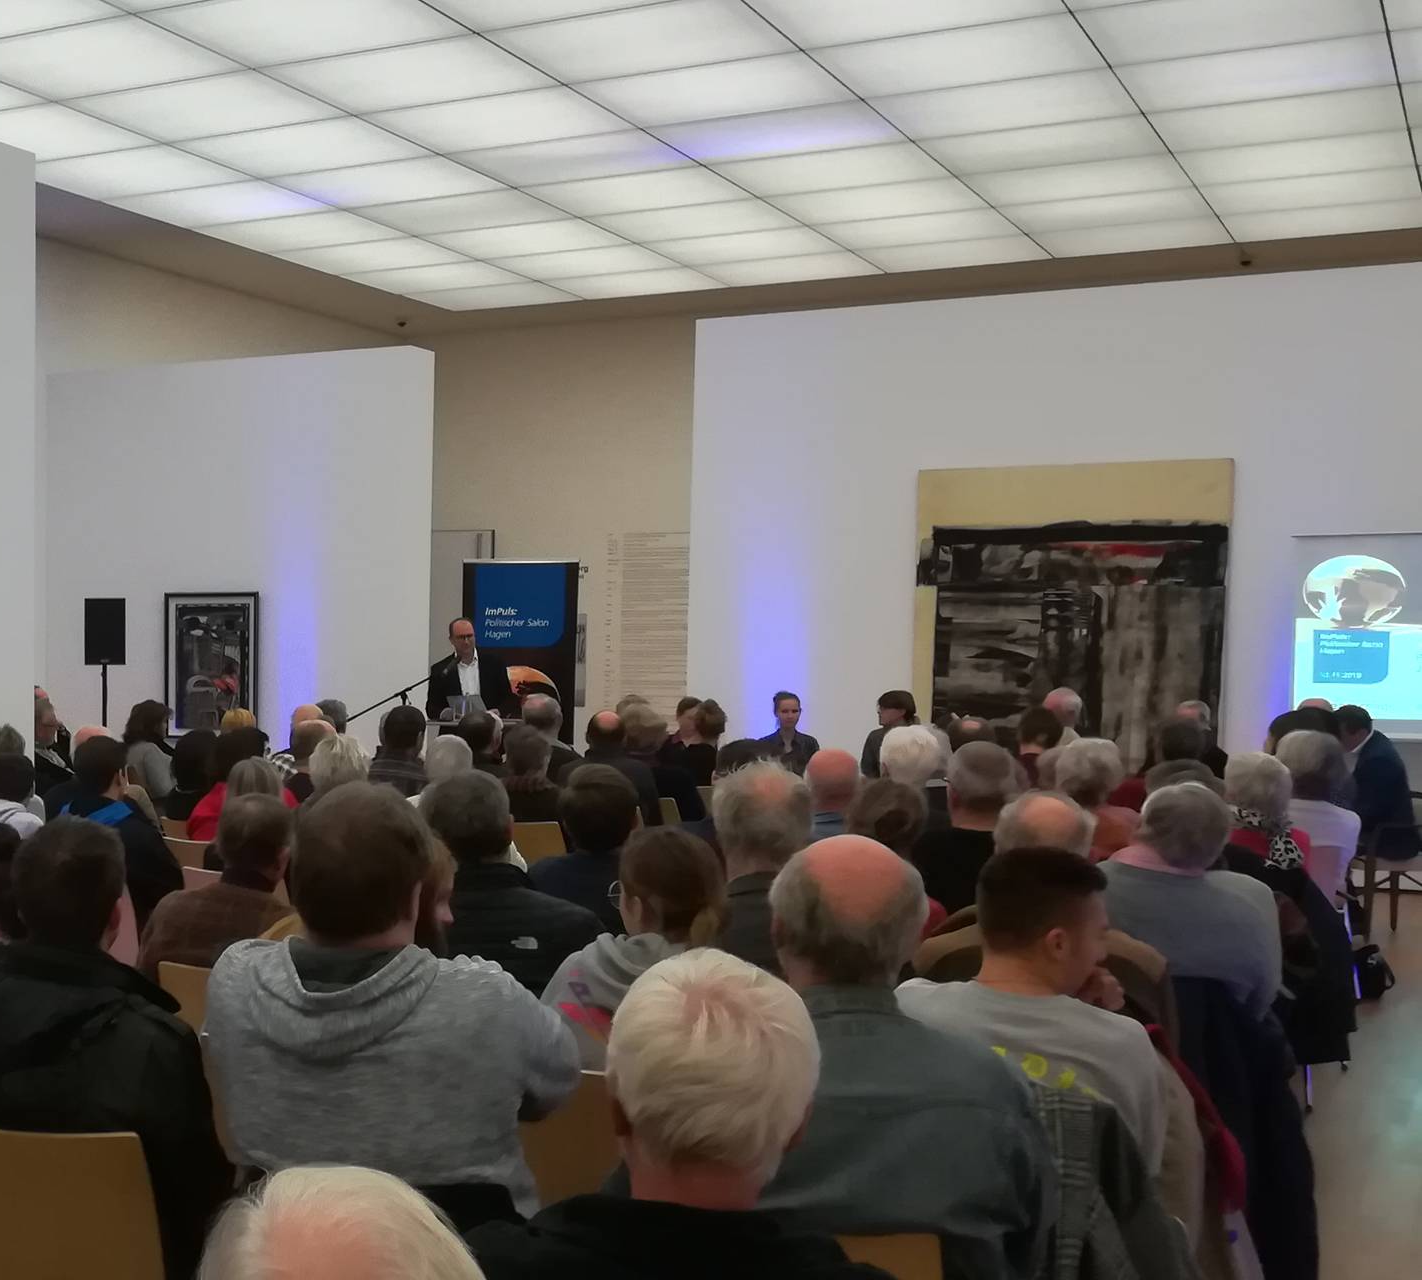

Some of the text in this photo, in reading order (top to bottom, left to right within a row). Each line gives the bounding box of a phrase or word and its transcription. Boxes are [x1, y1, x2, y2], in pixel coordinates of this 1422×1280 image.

[485, 608, 518, 616] ImPuls:
[485, 619, 549, 627] Politischer Salon
[485, 630, 511, 640] Hagen
